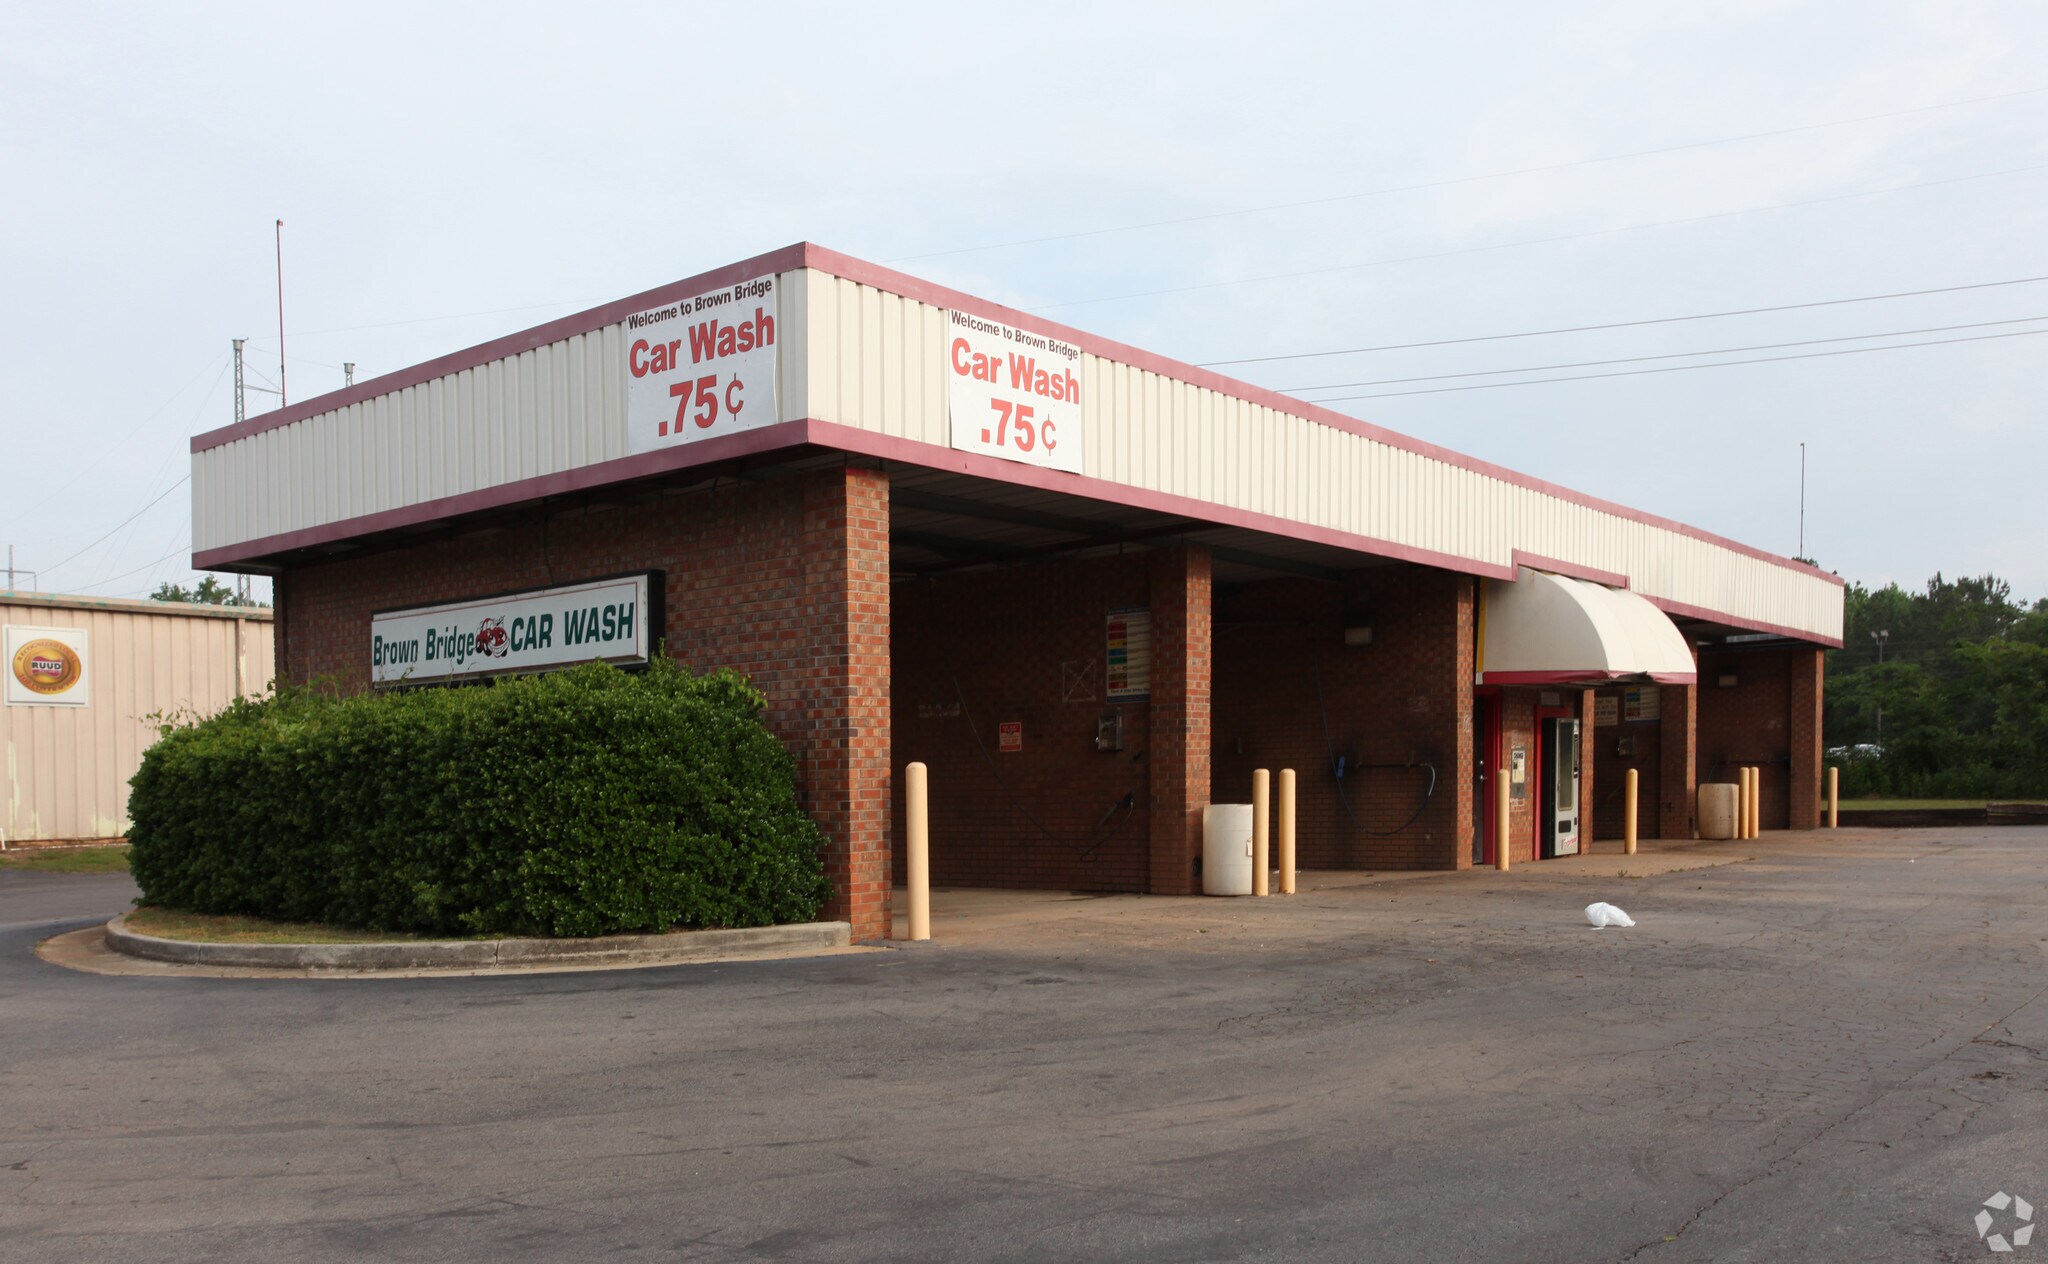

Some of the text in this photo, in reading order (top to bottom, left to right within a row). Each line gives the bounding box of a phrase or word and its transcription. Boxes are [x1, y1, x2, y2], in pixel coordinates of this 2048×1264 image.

[628, 280, 772, 330] Welcome to Brown Bridge
[629, 307, 775, 378] Car Wash
[951, 309, 1078, 360] Welcome to Brown Bridge
[951, 337, 1080, 405] Car Wash
[373, 602, 635, 666] Brown Bridge CAR WASH
[32, 661, 62, 670] RUUD
